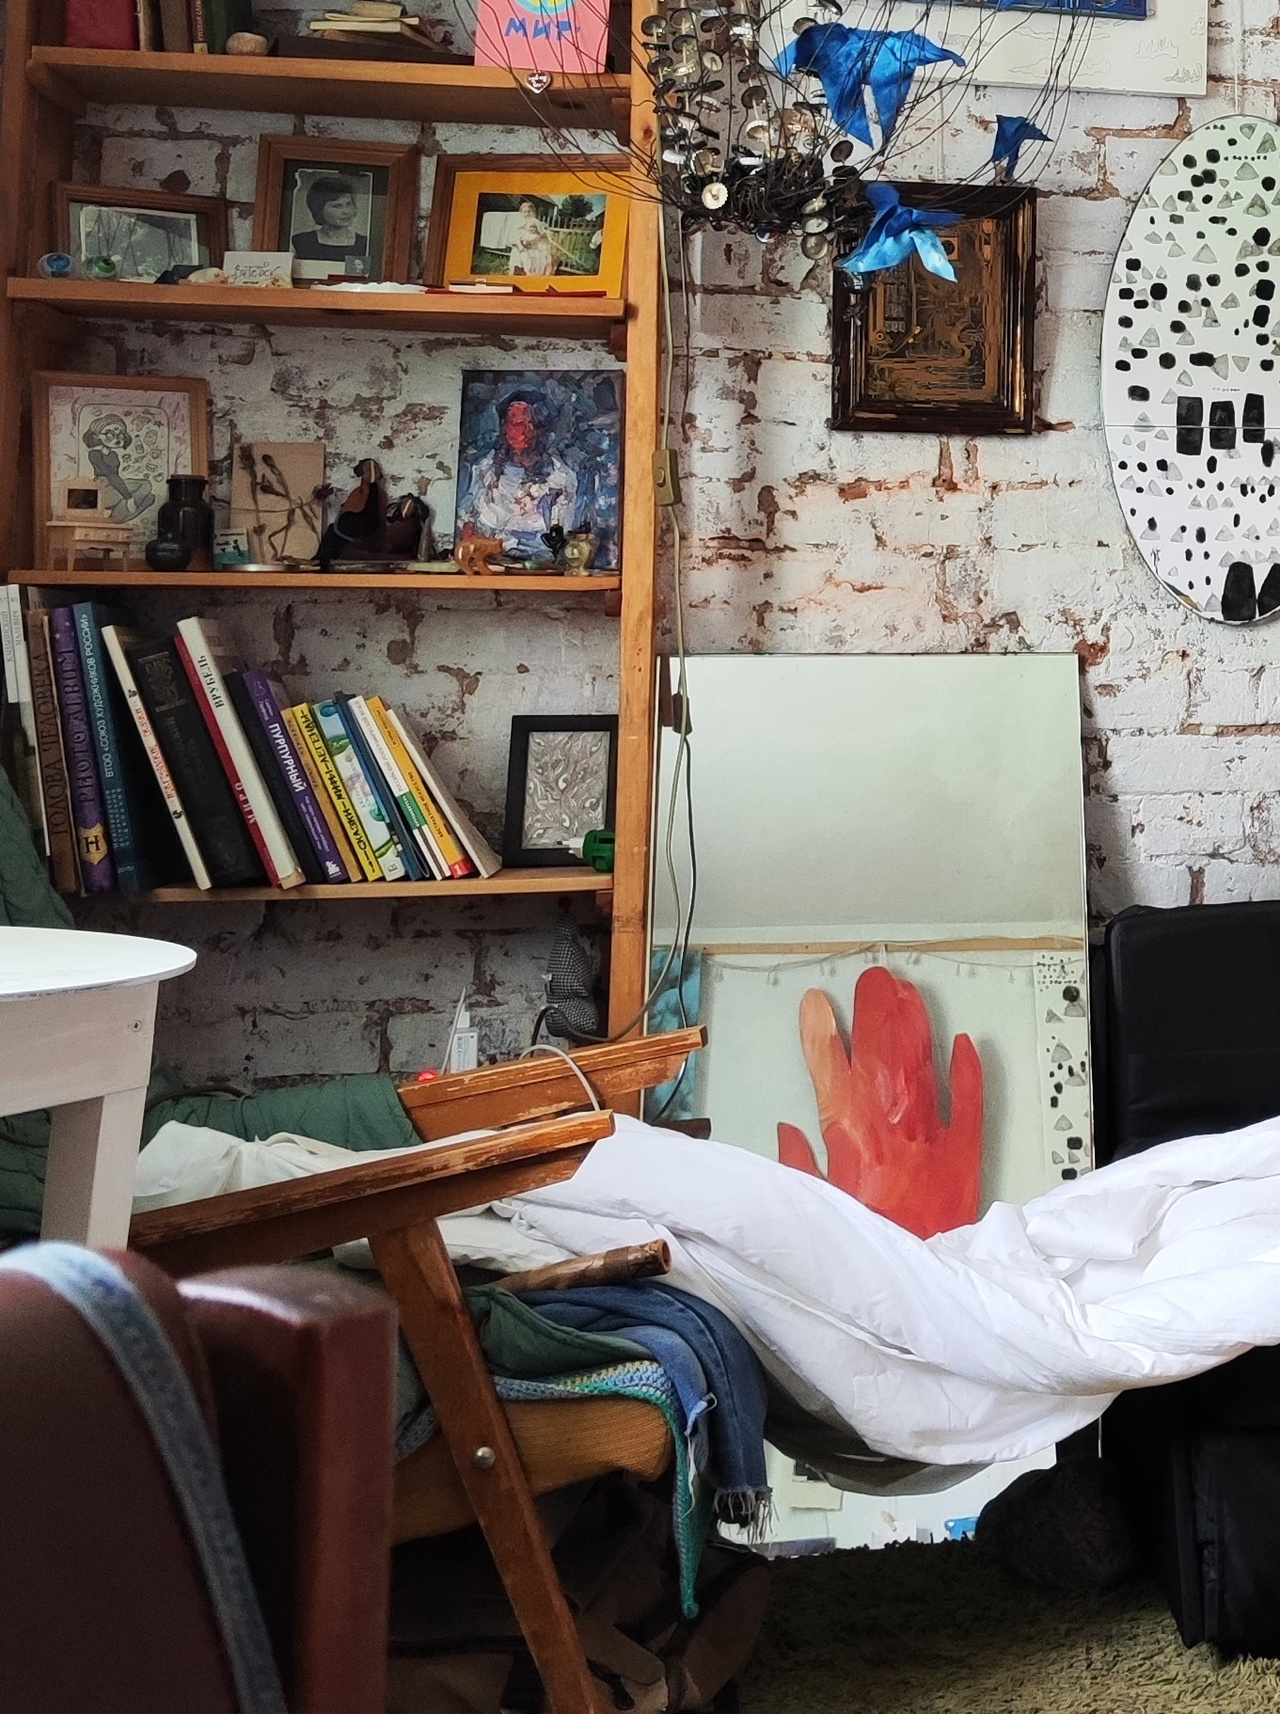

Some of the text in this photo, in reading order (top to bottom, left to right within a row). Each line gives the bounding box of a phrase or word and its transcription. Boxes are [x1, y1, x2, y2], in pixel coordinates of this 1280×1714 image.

[2, 610, 13, 663] КАНДИНСКИЙ
[12, 610, 20, 646] МАЛЕВИЧ
[80, 613, 114, 778] ВТОО «СОЮЗ ХУДОЖНИКОВ РОССИИ»
[198, 655, 225, 709] ВРУБЕЛЬ
[33, 653, 68, 835] ГОЛОВА ЧЕЛОВЕКА
[60, 648, 95, 803] PHOTO ALBUM
[269, 723, 307, 793] ПУРПУРНЫЙ
[234, 782, 256, 824] МИРО
